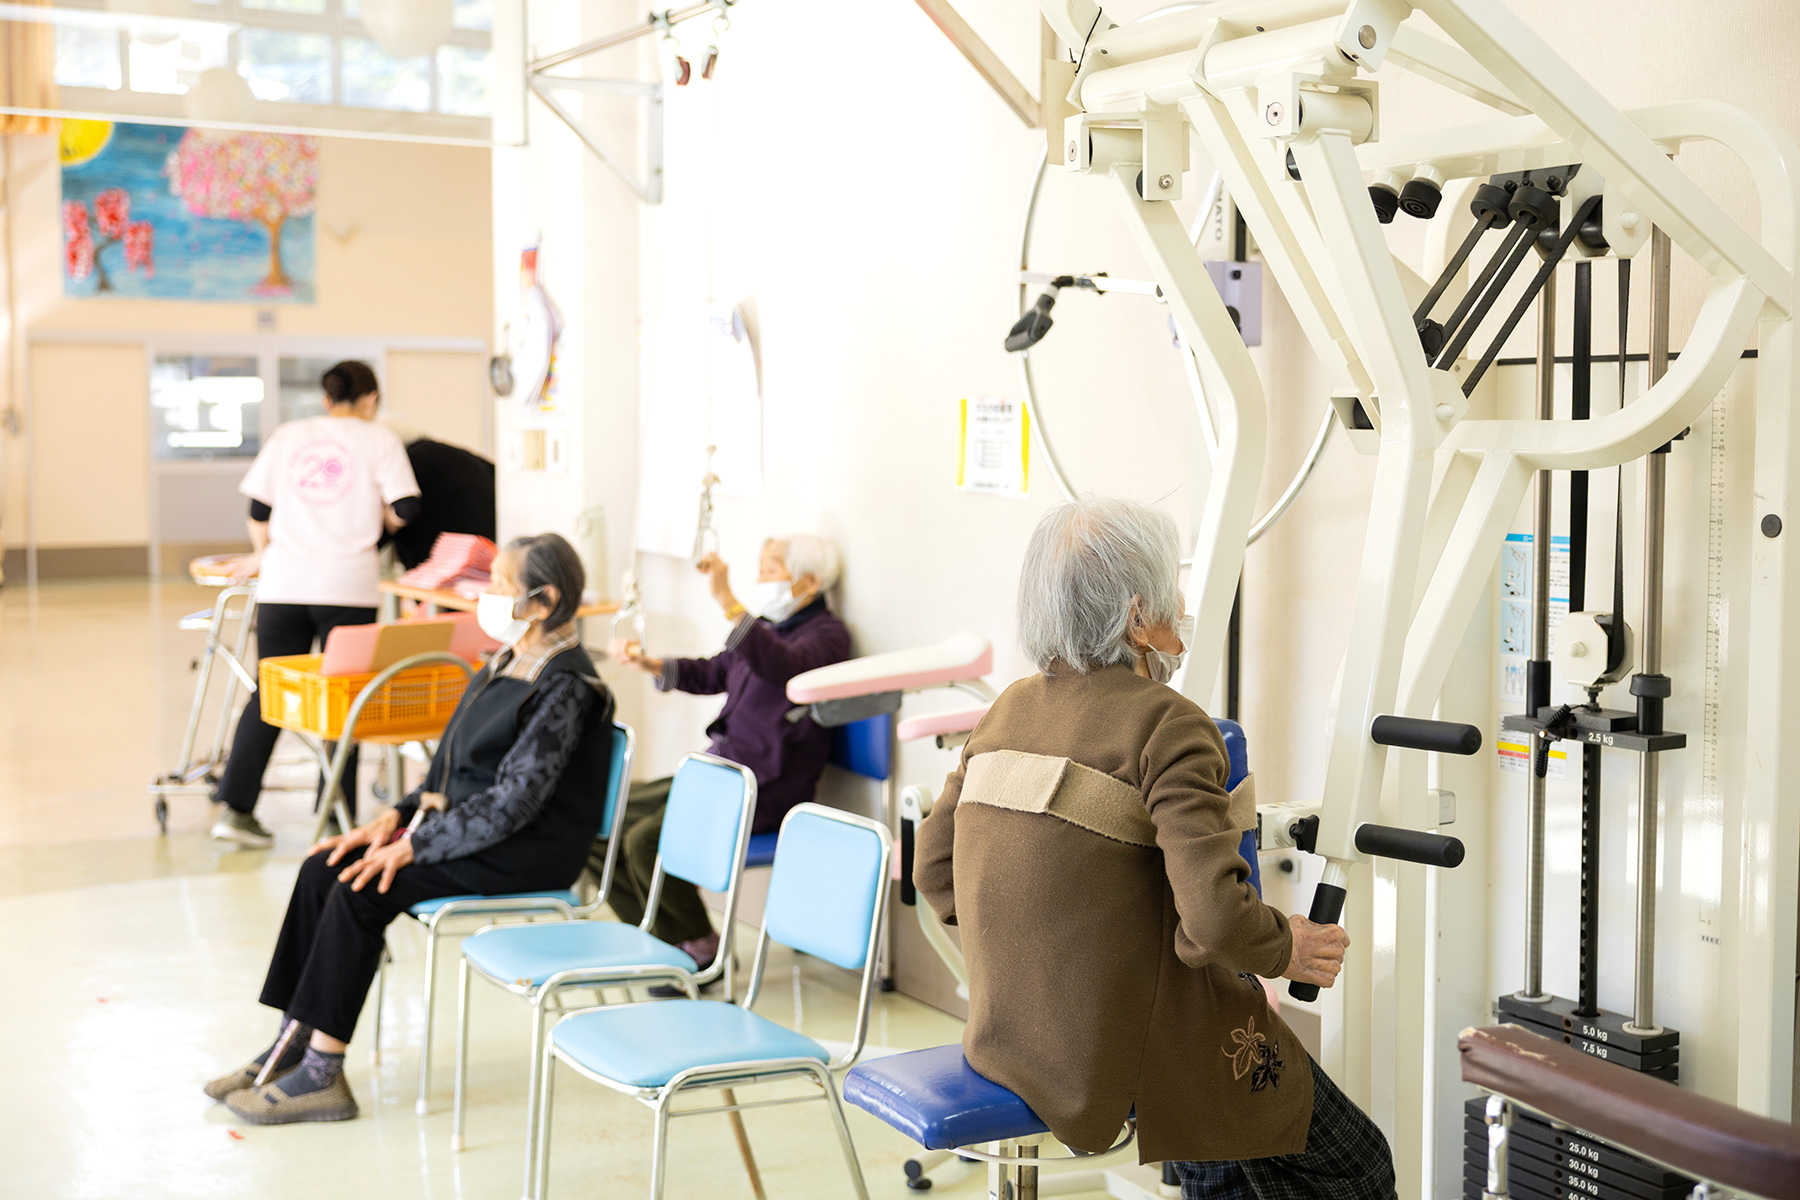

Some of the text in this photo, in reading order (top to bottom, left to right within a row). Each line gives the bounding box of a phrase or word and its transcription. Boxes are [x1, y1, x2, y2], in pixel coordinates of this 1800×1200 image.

[1588, 732, 1613, 745] 2.5 kg
[1582, 1024, 1608, 1041] 5.0 kg
[1582, 1041, 1608, 1059] 7.5 kg
[1569, 1141, 1599, 1161] 25.0 kg
[1568, 1158, 1599, 1179] 30.0 kg
[1568, 1175, 1598, 1196] 35.0 kg
